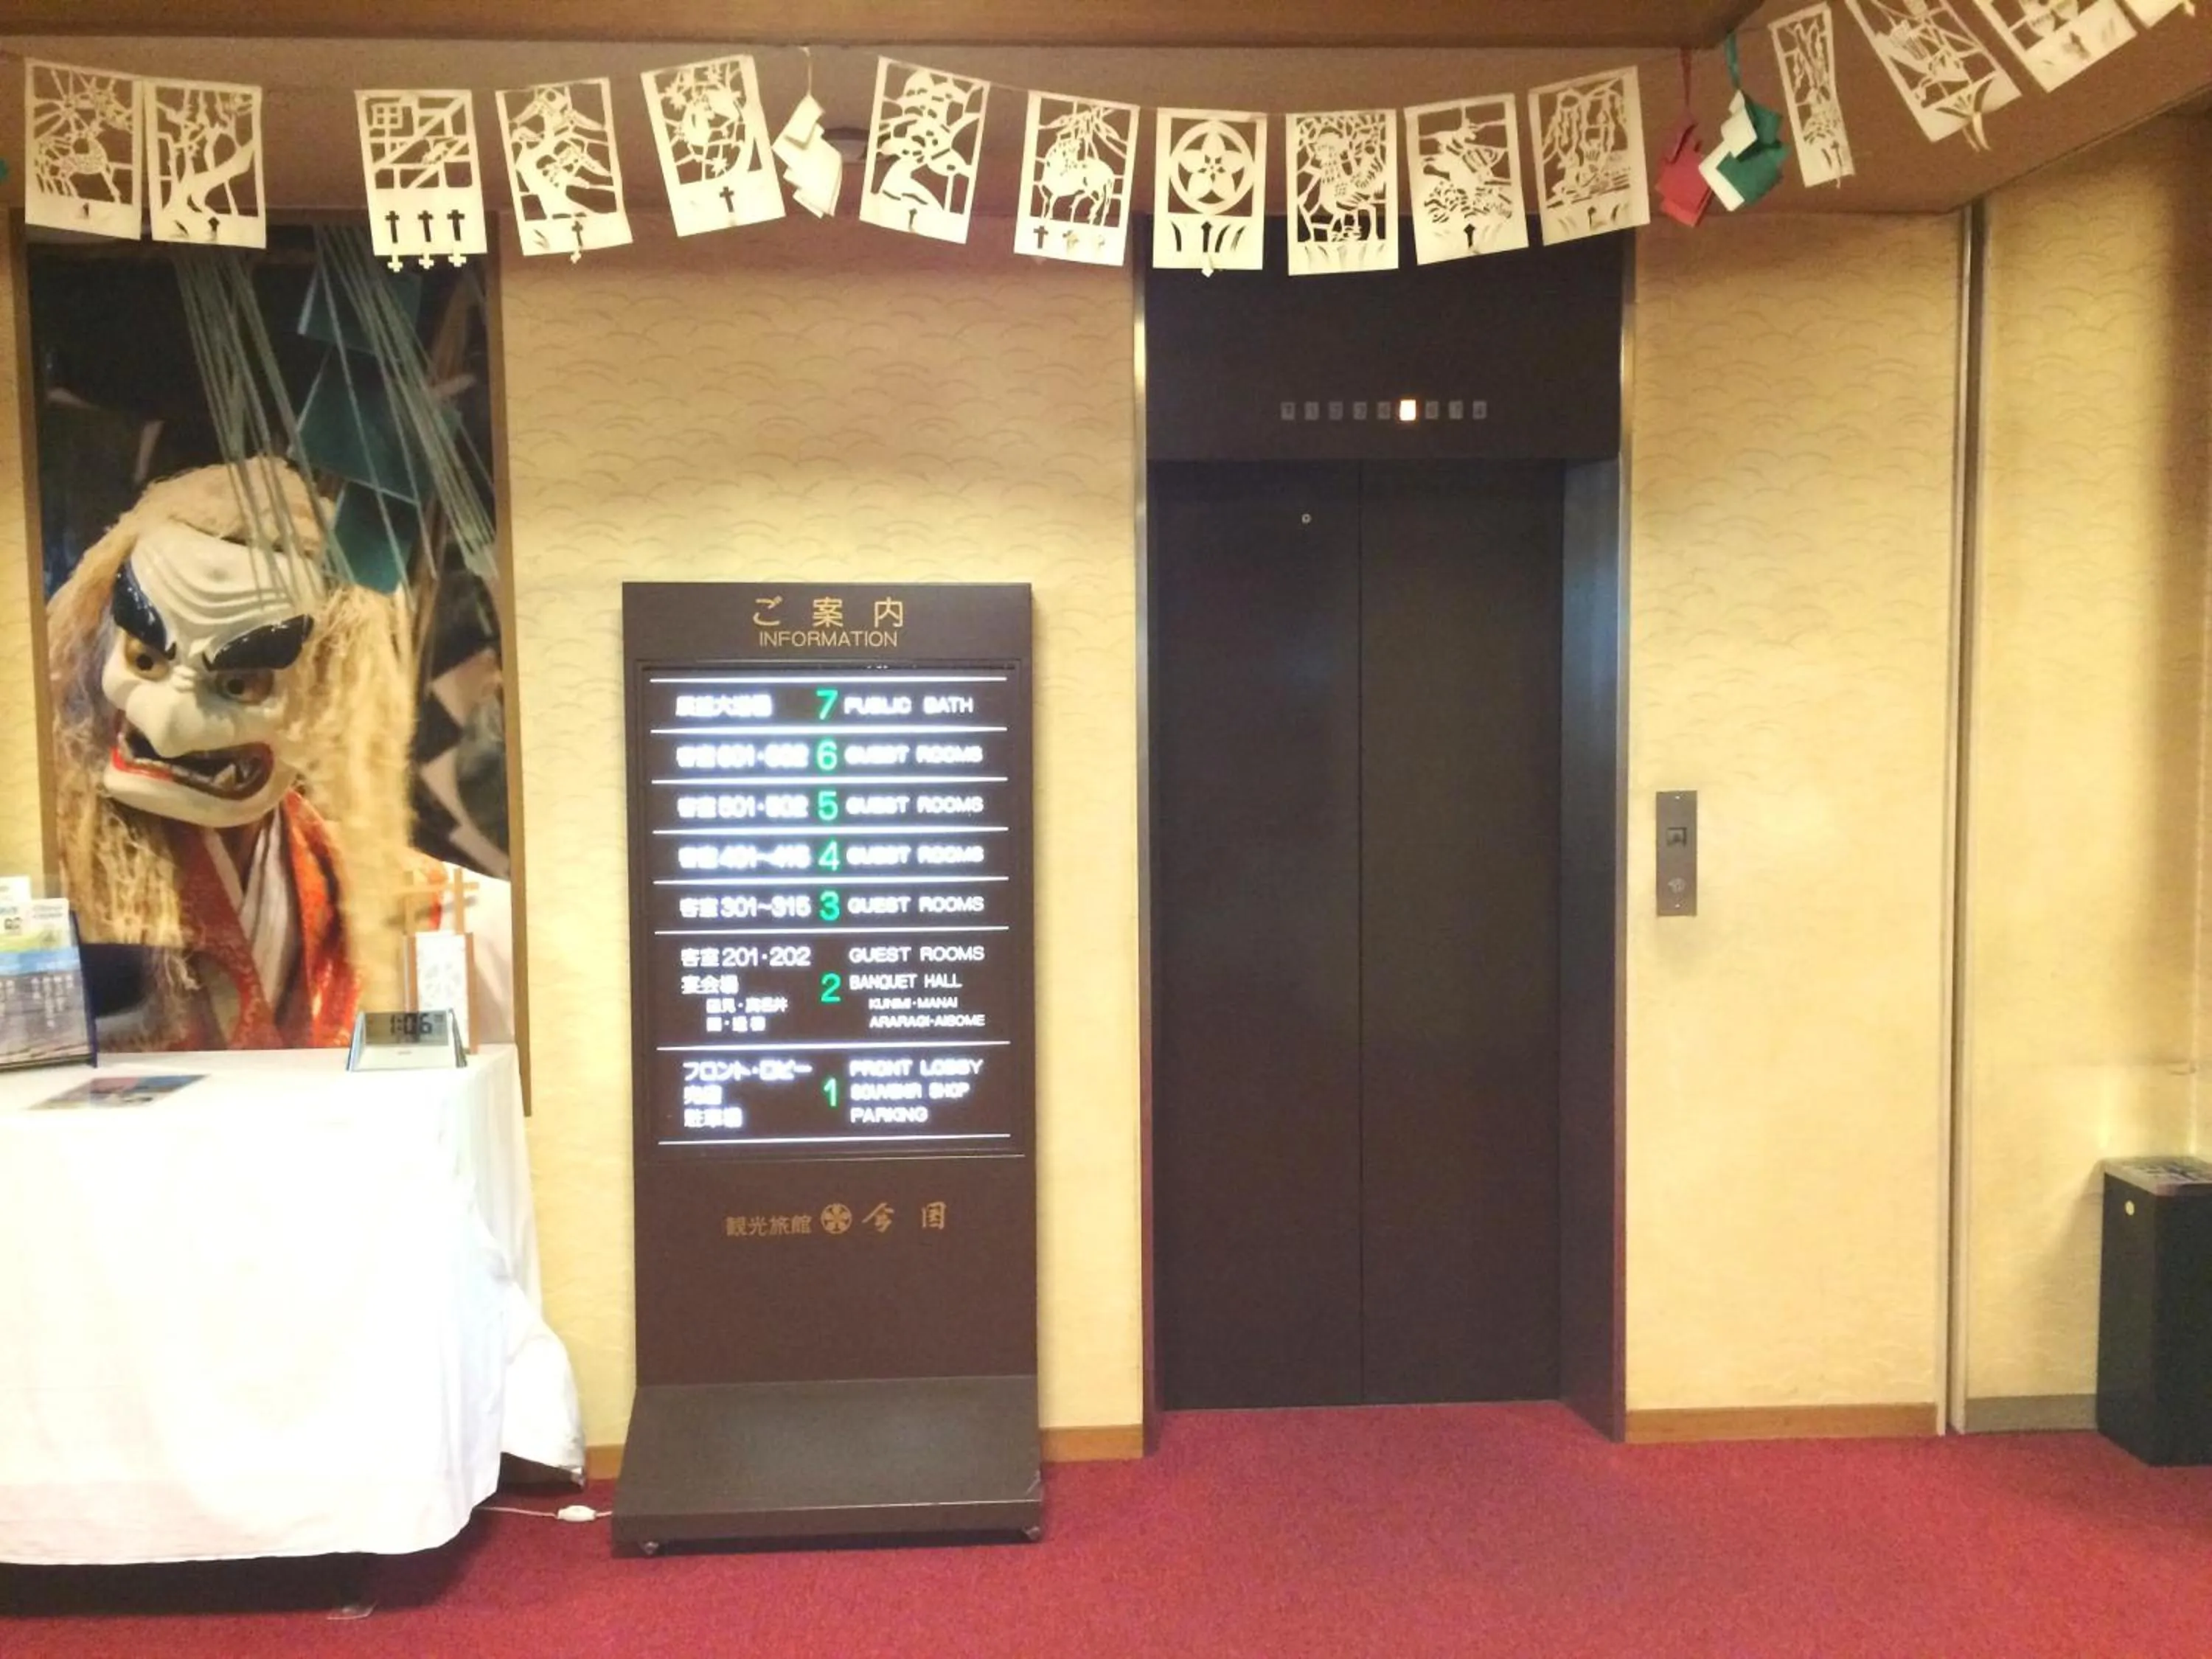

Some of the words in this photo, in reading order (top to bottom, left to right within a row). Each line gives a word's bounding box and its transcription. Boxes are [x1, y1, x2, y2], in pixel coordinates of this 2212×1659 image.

[759, 630, 898, 647] INFORMATION
[816, 689, 839, 720] 7
[844, 697, 912, 716] PUBLIC
[924, 697, 974, 715] BATH
[817, 740, 838, 771] 6
[916, 745, 984, 765] ROOMS
[818, 791, 838, 819] 5
[917, 796, 984, 814] ROOMS
[818, 841, 840, 871] 4
[917, 846, 984, 865] ROOMS
[820, 890, 840, 920] 3
[849, 897, 911, 914] GUEST
[919, 897, 984, 913] ROOMS
[849, 947, 912, 964] GUEST
[921, 947, 985, 962] ROOMS
[821, 973, 841, 1002] 2
[850, 974, 918, 990] BANQUET
[925, 975, 962, 989] HALL
[850, 1060, 914, 1078] FRONT
[921, 1059, 984, 1077] LOBBY
[824, 1077, 837, 1107] 1
[930, 1082, 970, 1100] SHOP
[851, 1107, 929, 1123] PARKING
[725, 1215, 812, 1237] 観光旅館
